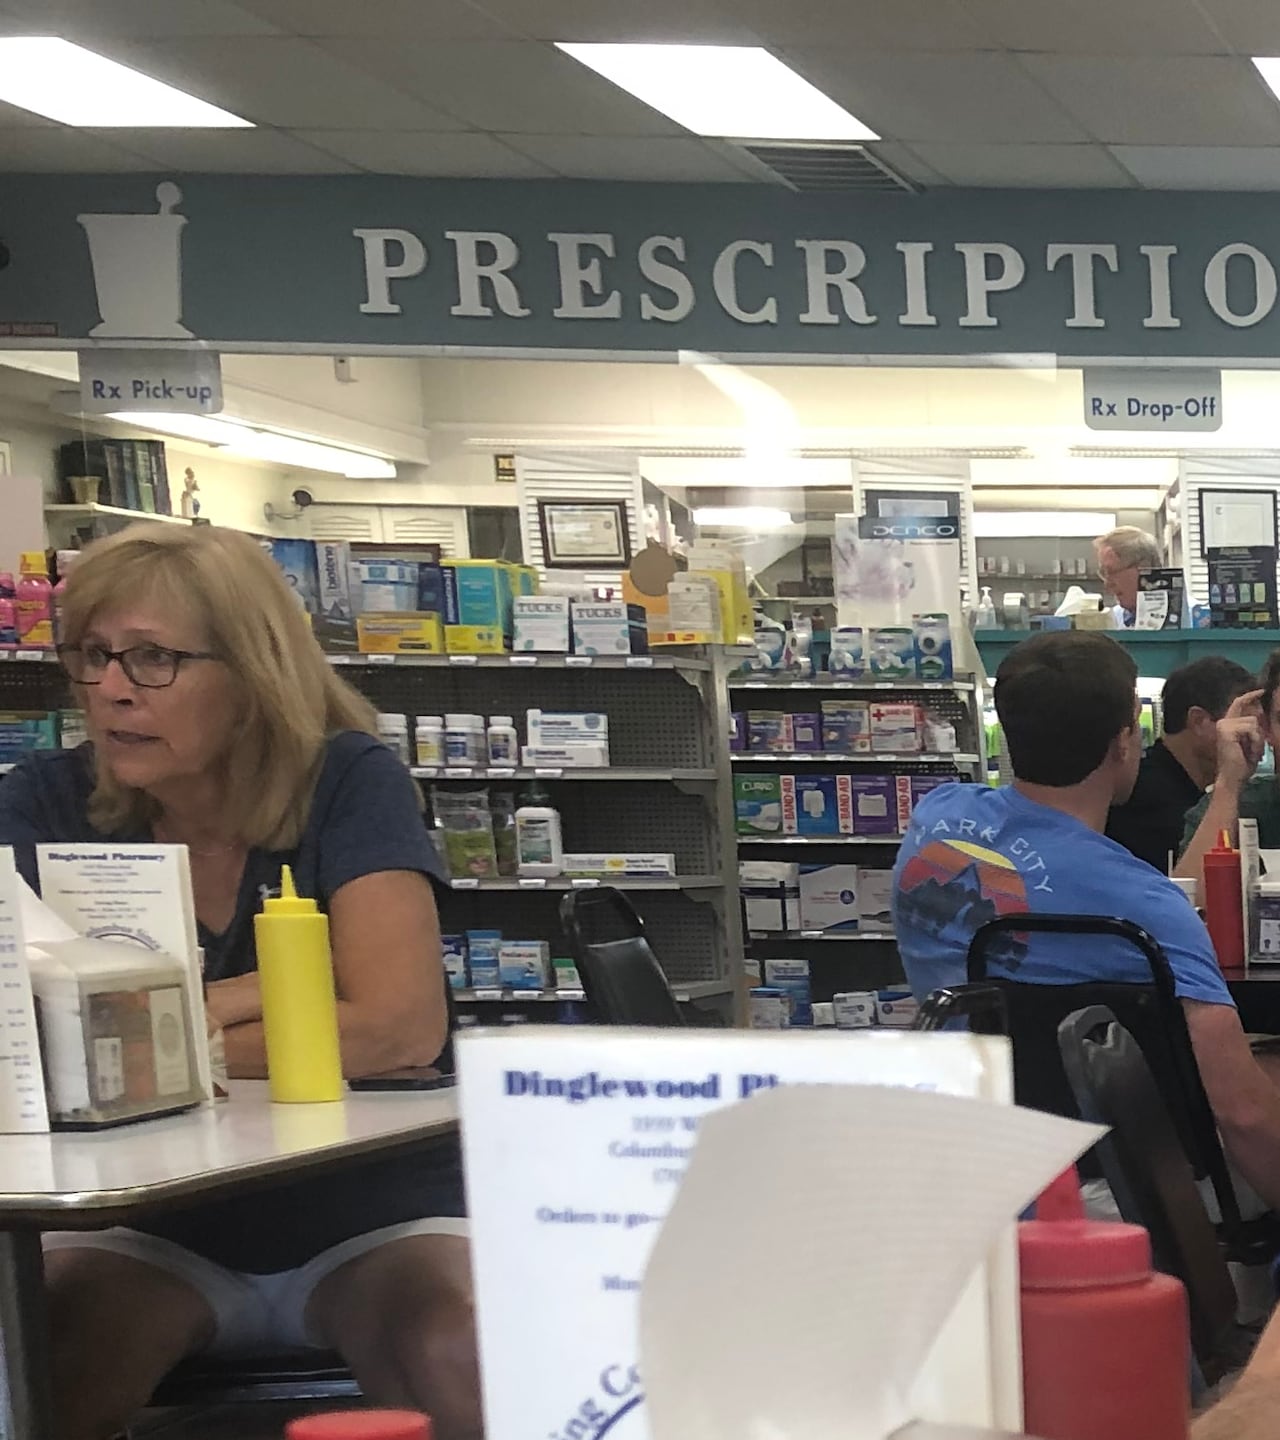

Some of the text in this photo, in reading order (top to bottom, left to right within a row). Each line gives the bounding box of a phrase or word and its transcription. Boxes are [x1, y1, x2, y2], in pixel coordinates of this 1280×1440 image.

[92, 379, 212, 404] Rx Pick-up
[1091, 396, 1216, 422] Rx Drop-Off
[518, 603, 563, 613] TUCKS
[576, 608, 622, 618] TUCKS
[915, 818, 1054, 893] PARK CITY
[504, 1070, 721, 1104] Dinglewood
